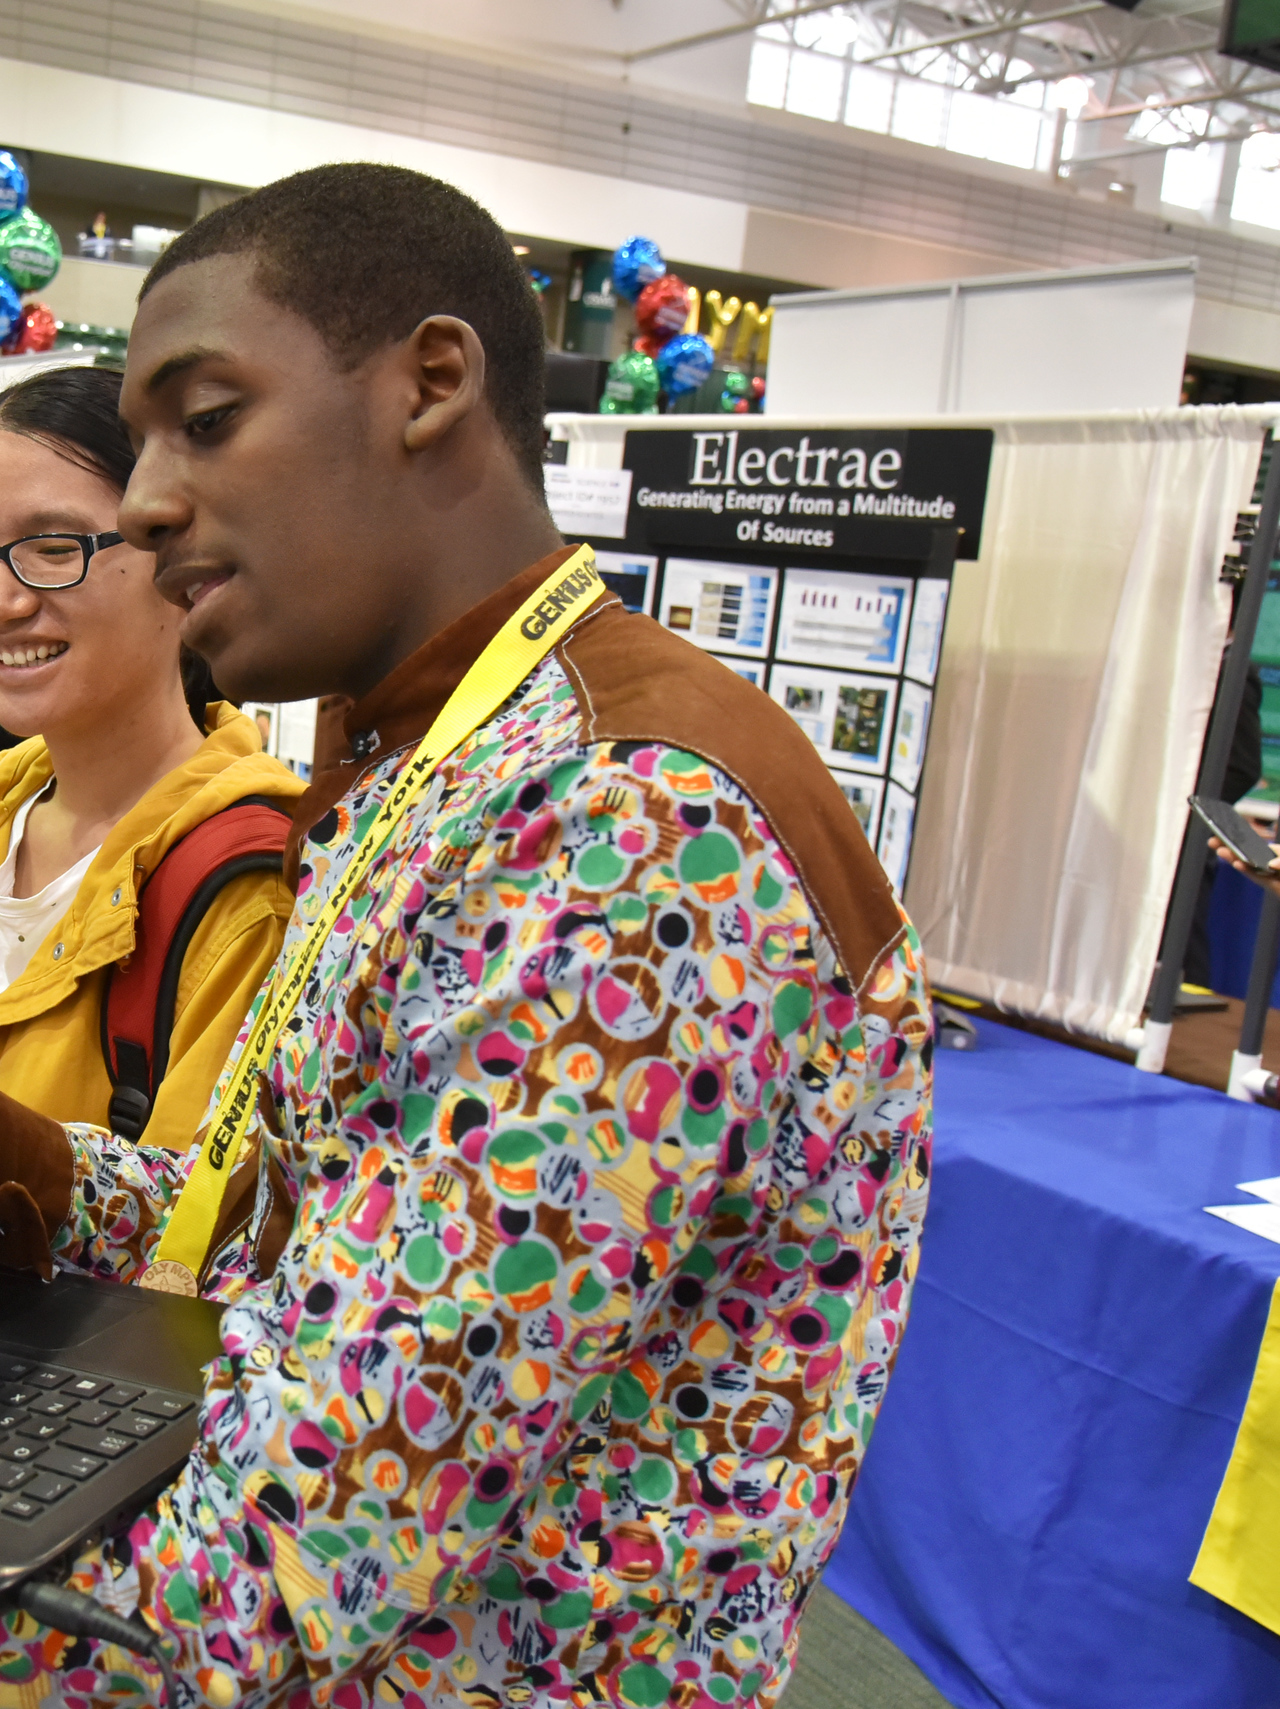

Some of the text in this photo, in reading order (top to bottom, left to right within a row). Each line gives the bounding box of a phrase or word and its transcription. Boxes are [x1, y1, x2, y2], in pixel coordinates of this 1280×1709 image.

[688, 431, 902, 490] Electrae
[636, 488, 955, 519] Generating Energy from a Multitude
[737, 520, 834, 547] Of Sources
[521, 567, 592, 641] GENIUS
[209, 753, 435, 1171] GENIUS Olympiad New York
